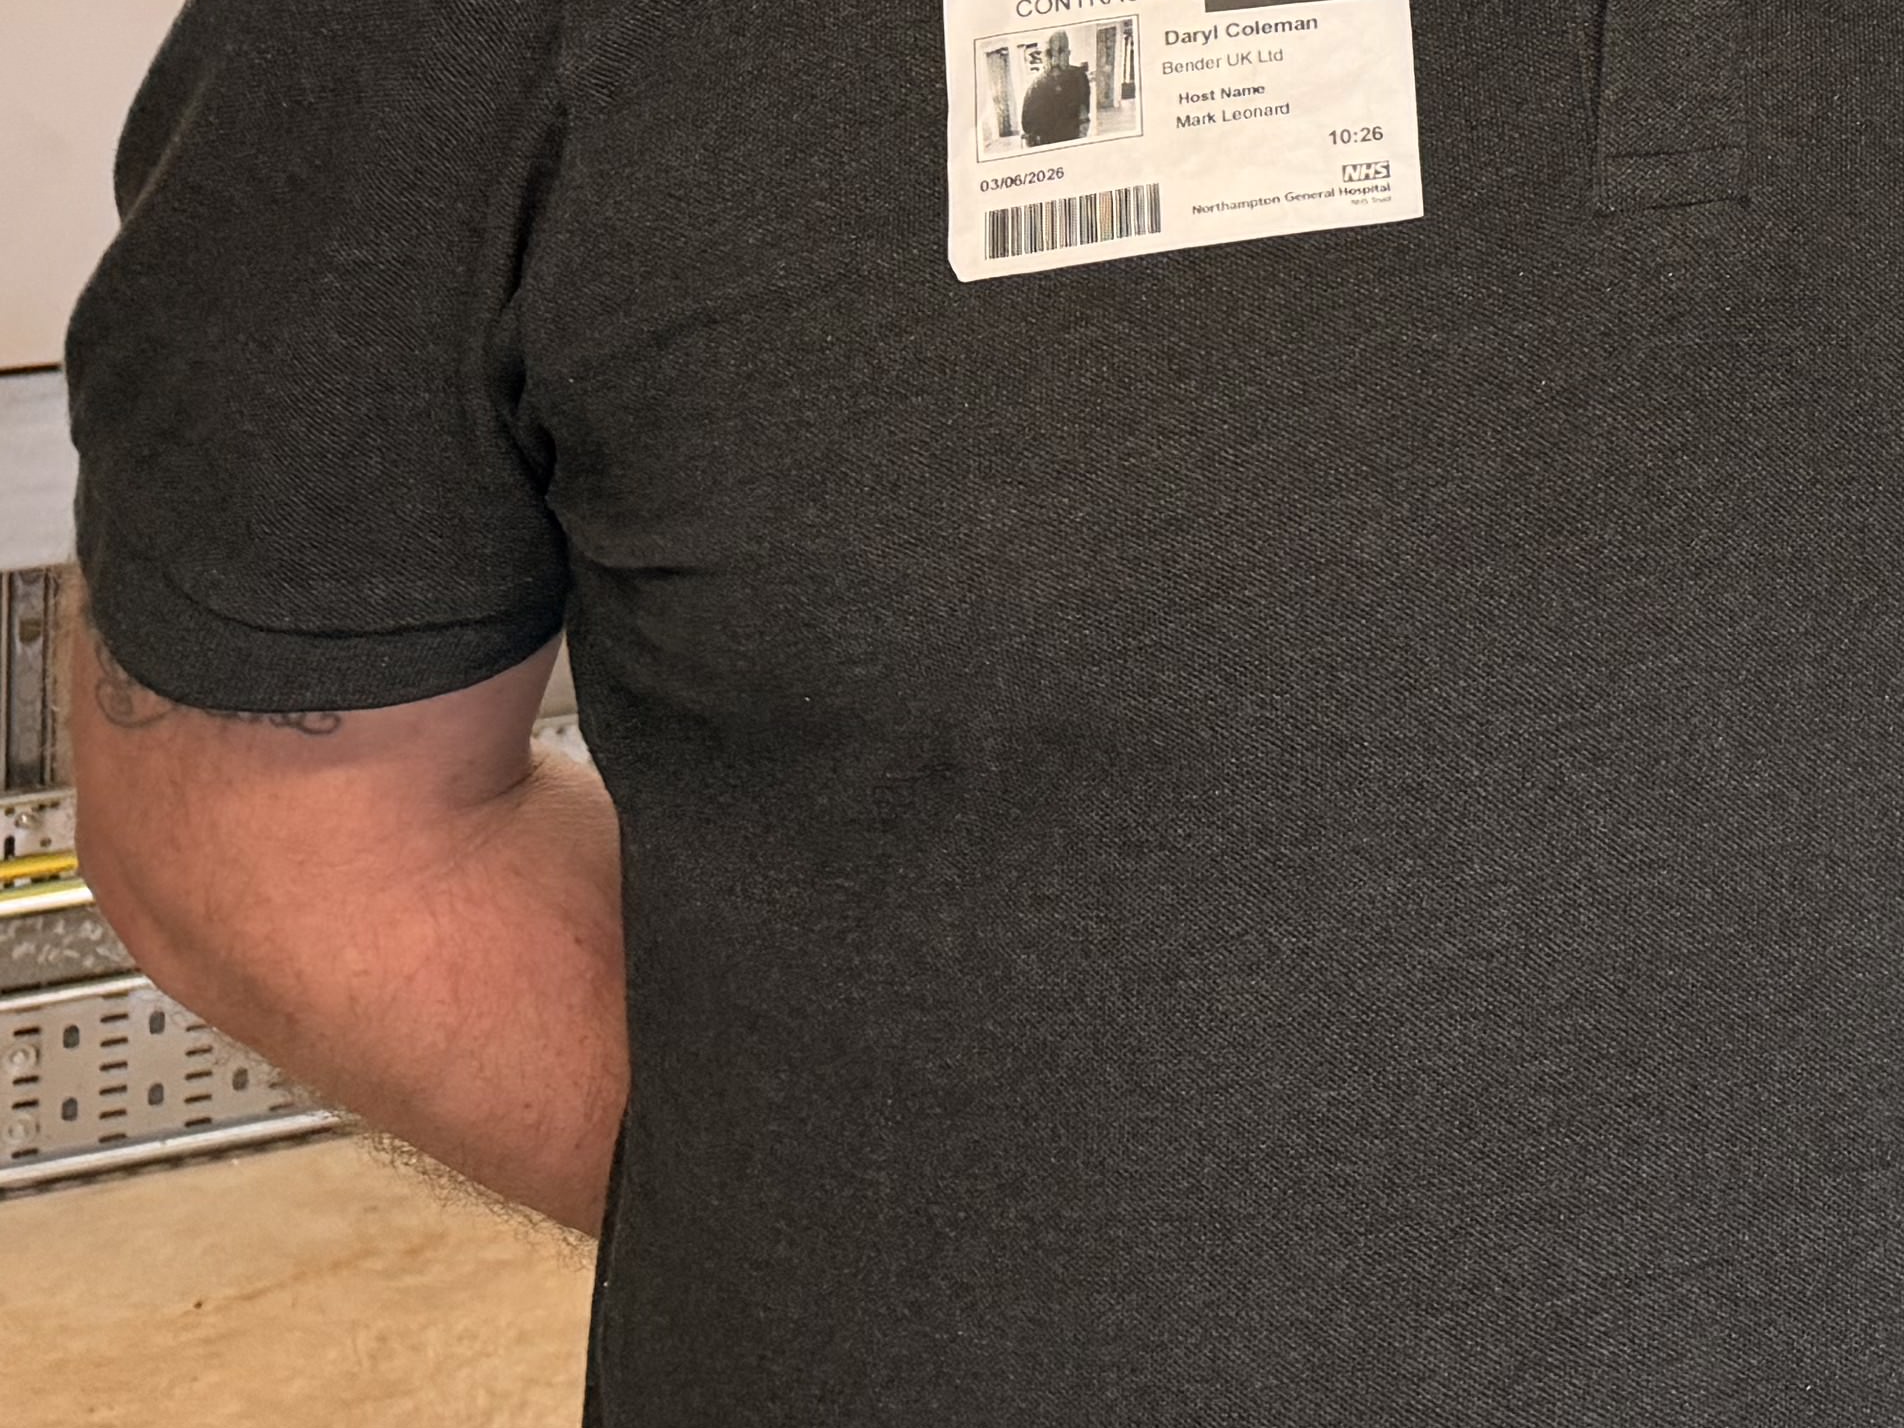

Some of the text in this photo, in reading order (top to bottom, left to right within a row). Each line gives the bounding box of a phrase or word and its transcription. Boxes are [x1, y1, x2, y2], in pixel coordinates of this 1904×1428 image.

[1164, 16, 1318, 46] Daryl Coleman
[1162, 47, 1284, 75] Bender UK Ltd
[1178, 83, 1265, 104] Host Name
[1176, 102, 1291, 129] Mark Leonard
[1328, 126, 1385, 146] 10:26
[980, 167, 1065, 192] 03/06/2026
[1342, 161, 1390, 182] NHS
[1192, 194, 1281, 215] Northampton
[1285, 188, 1335, 204] General
[1338, 182, 1391, 199] Hospital
